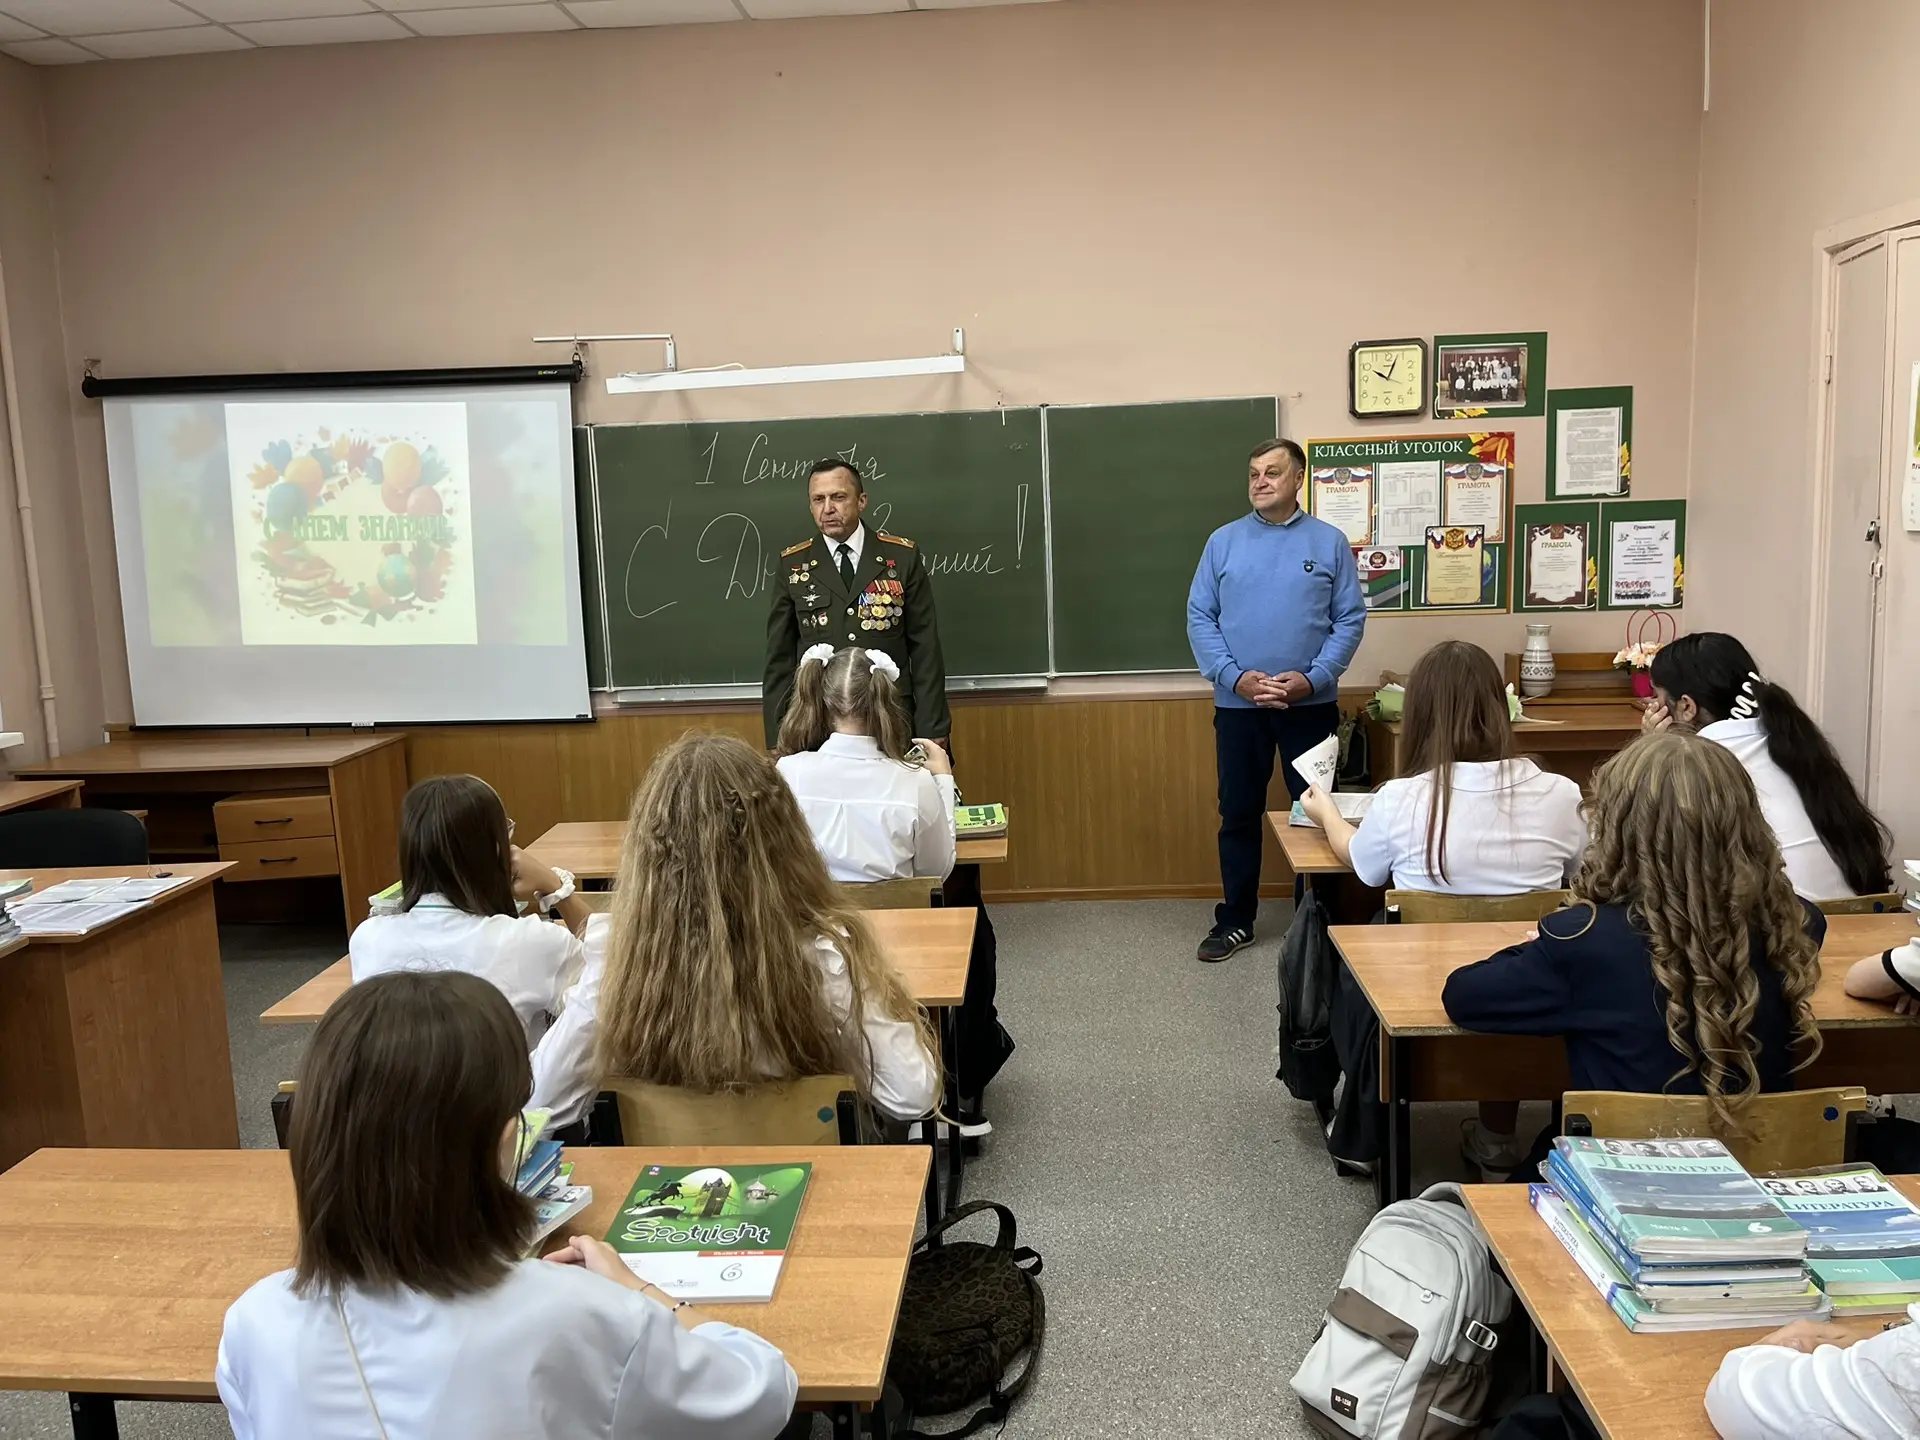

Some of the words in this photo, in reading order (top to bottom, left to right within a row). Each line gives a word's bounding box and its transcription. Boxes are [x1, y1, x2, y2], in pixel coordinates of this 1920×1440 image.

[1406, 360, 1415, 369] 2
[695, 431, 720, 485] 1
[1314, 440, 1399, 458] КЛАССНЫЙ
[1403, 440, 1464, 455] УГОЛОК
[1541, 541, 1572, 549] ГРАМОТА
[1597, 1154, 1735, 1174] ЛИТЕРАТУРА
[621, 1216, 771, 1246] Spotlight
[1747, 1221, 1773, 1233] 6
[719, 1262, 743, 1282] 6
